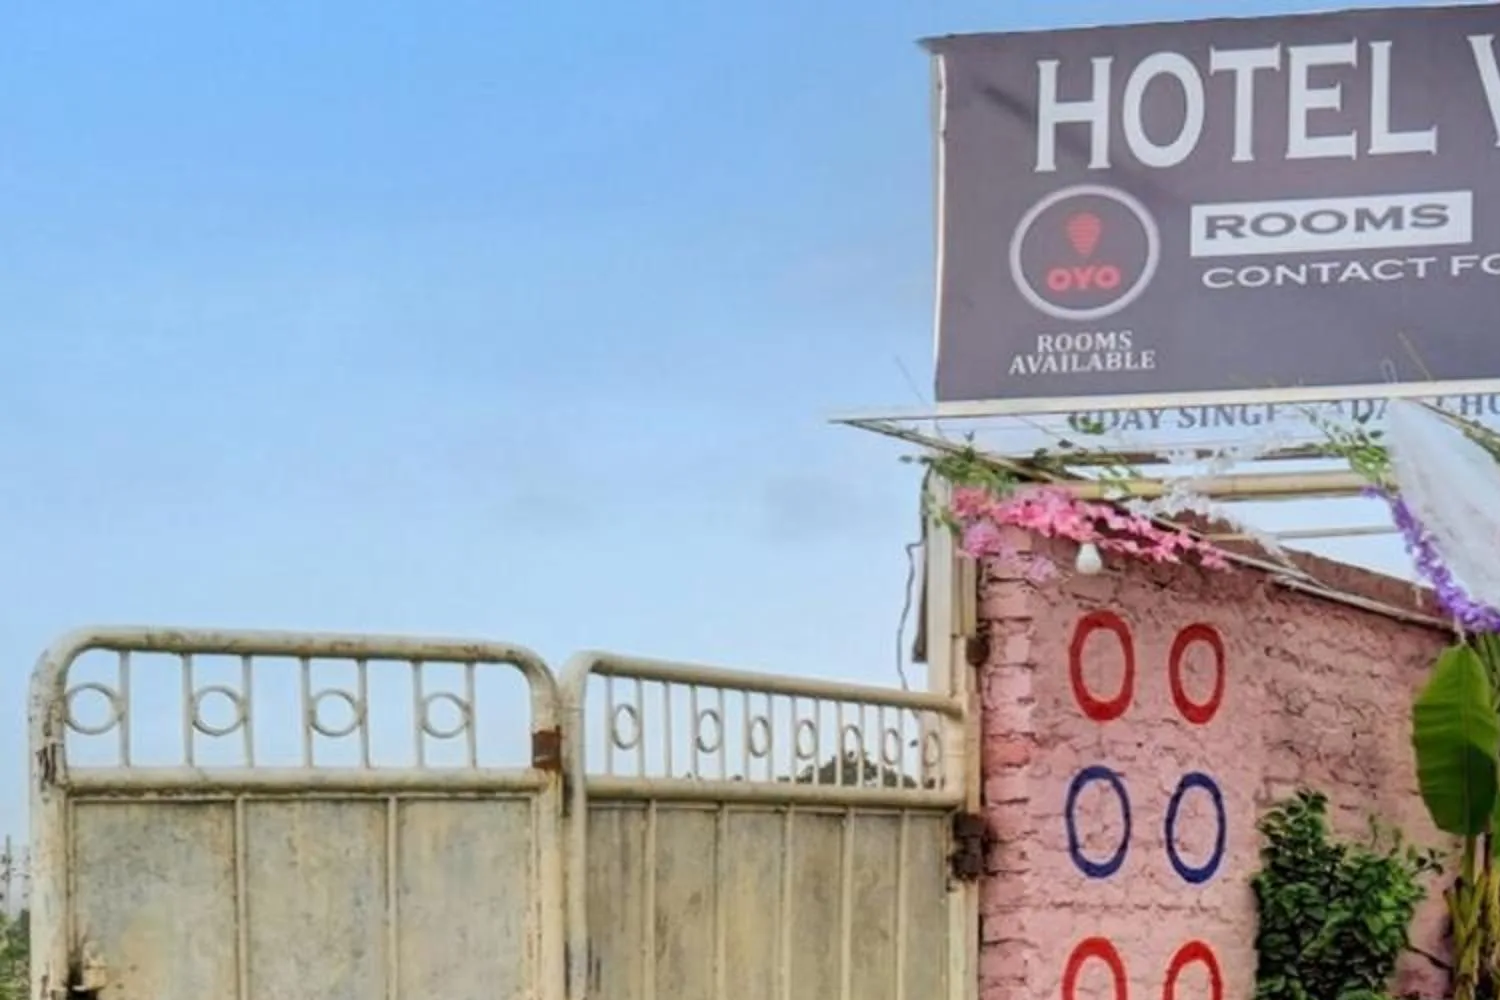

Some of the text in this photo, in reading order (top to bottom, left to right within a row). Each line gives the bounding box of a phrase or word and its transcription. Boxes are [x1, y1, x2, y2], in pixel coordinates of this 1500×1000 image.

[1034, 37, 1438, 173] HOTEL
[1203, 203, 1450, 241] ROOMS
[1046, 264, 1122, 293] OYO
[1201, 256, 1438, 289] CONTACT
[1036, 330, 1133, 354] ROOMS
[1008, 350, 1156, 376] AVAILABLE
